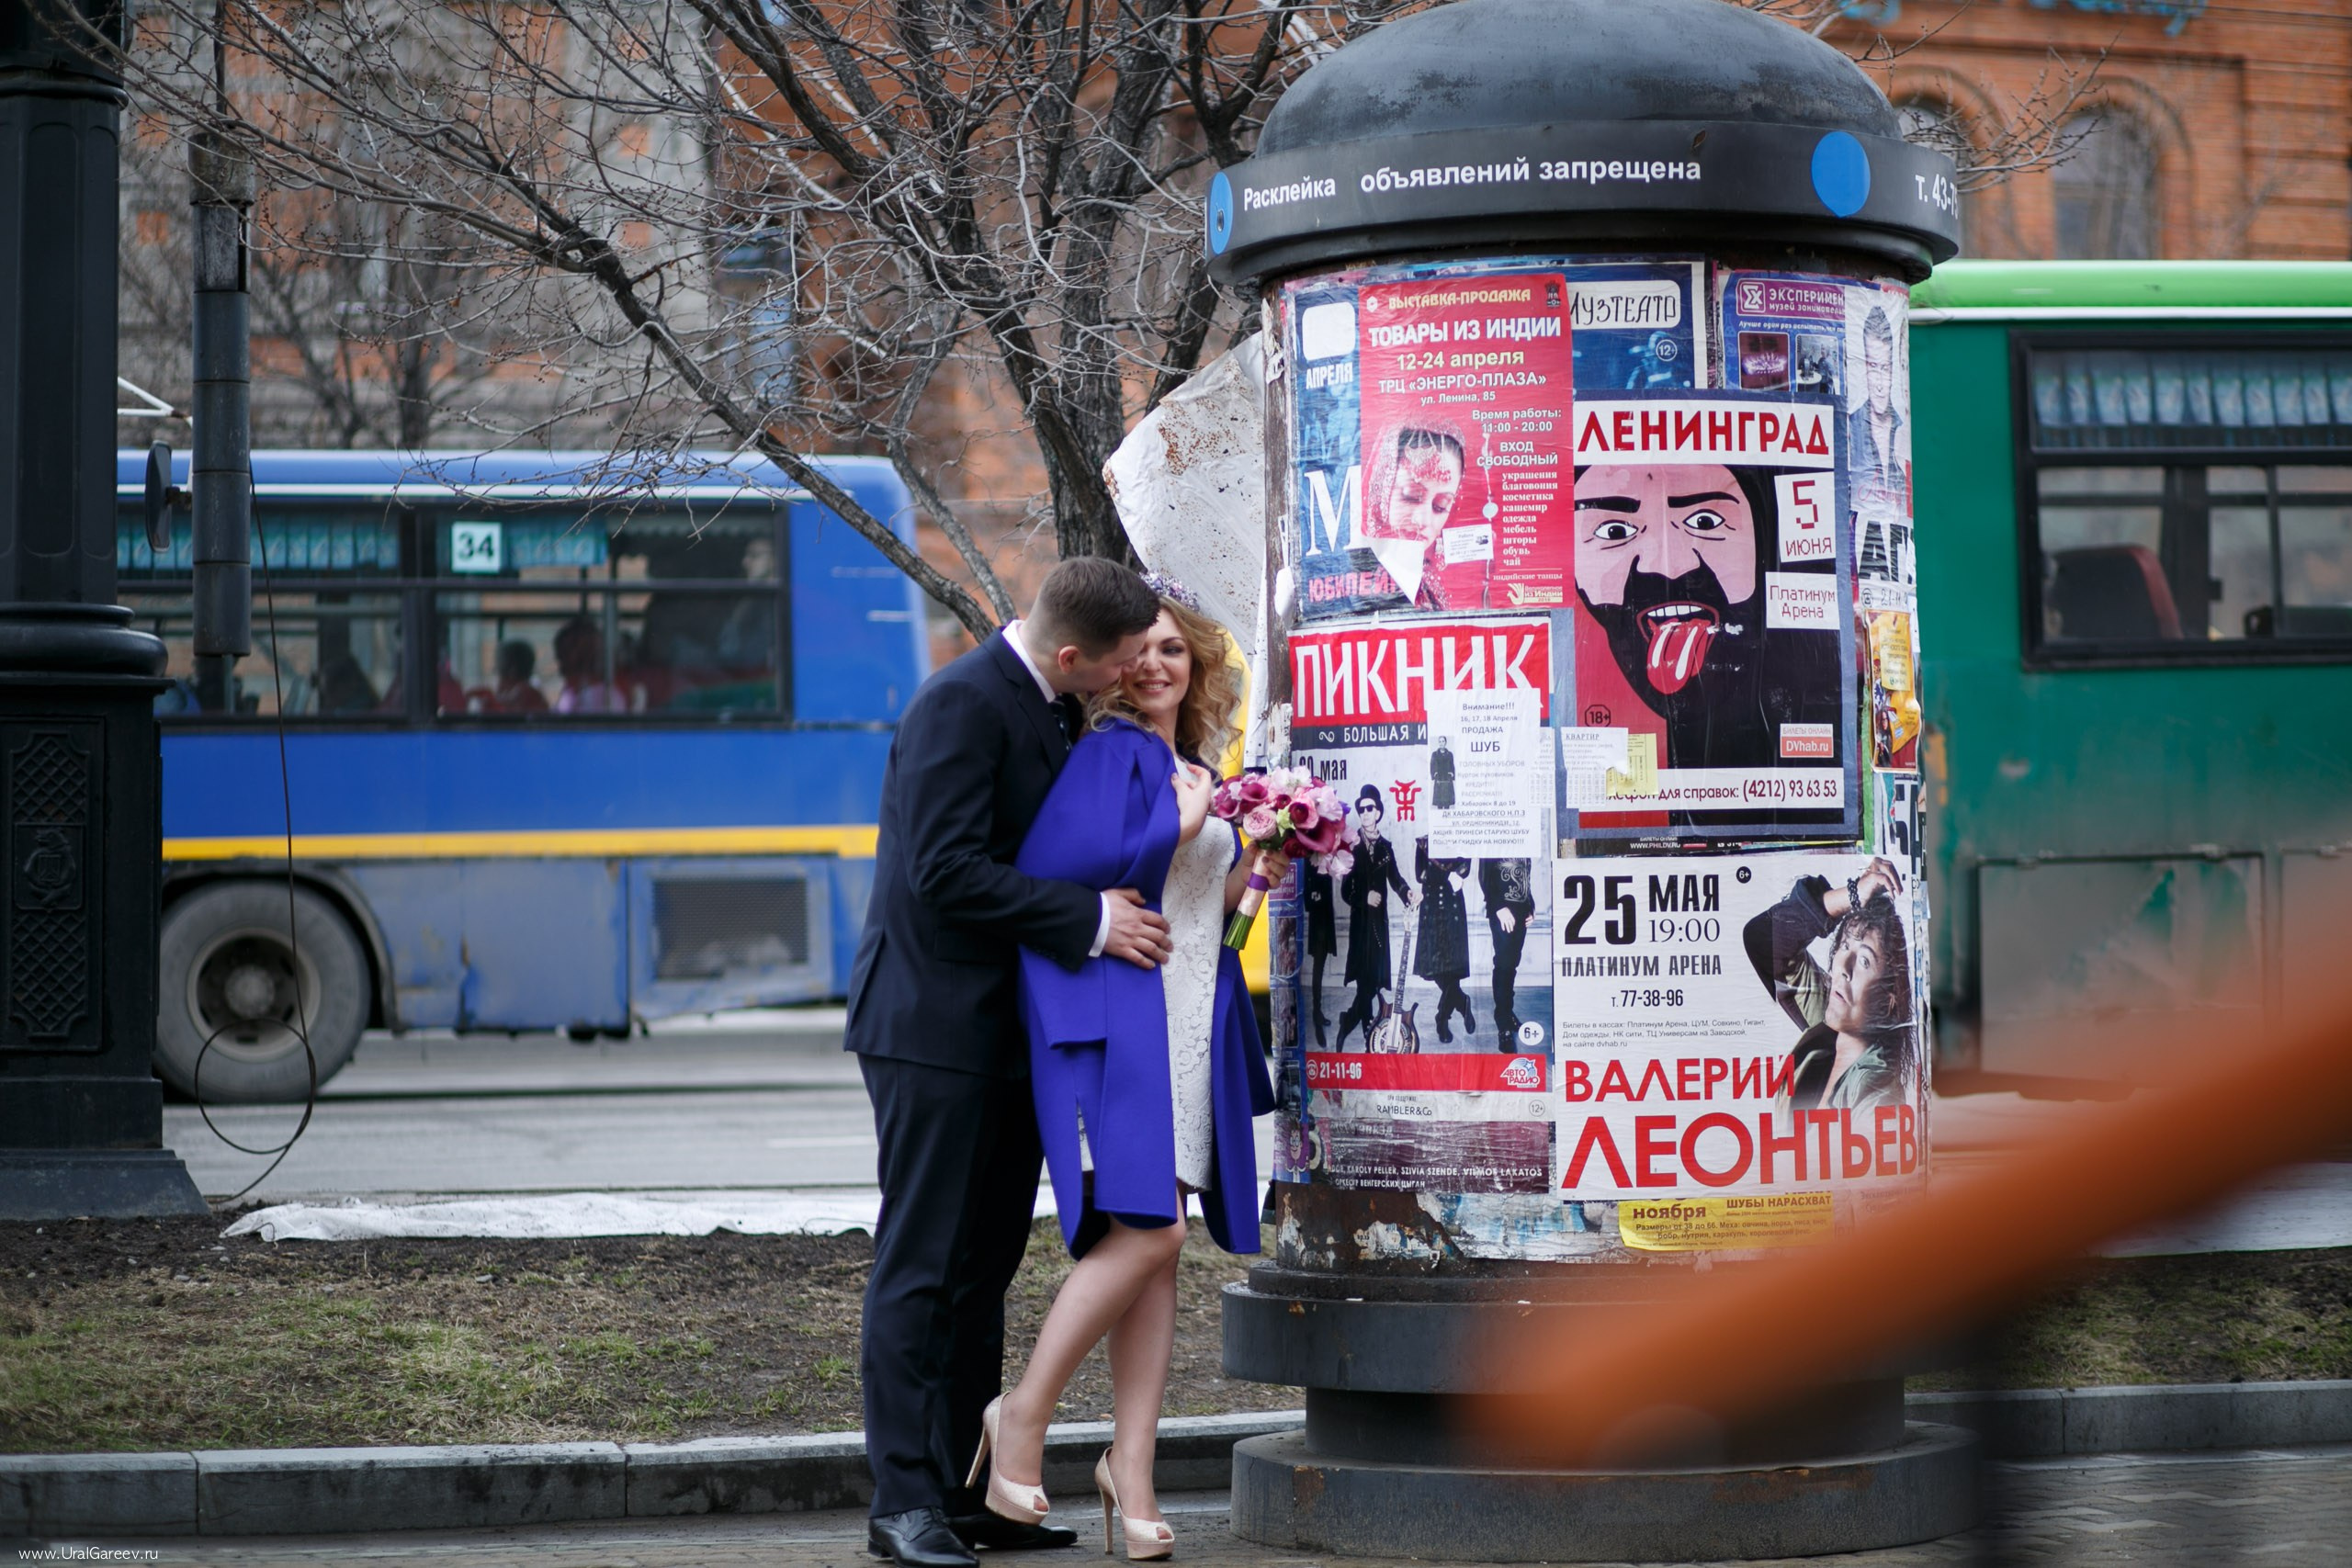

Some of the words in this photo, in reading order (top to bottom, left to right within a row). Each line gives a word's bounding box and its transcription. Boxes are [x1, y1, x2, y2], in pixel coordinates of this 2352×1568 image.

[1243, 175, 1336, 211] Расклейка
[1361, 156, 1530, 193] объявлений
[1539, 159, 1702, 185] запрещена
[1388, 288, 1531, 310] ВЫСТАВКА-ПРОДАЖА
[1770, 303, 1794, 312] музей
[1368, 322, 1448, 347] ТОВАРЫ
[1453, 321, 1480, 342] ИЗ
[1486, 317, 1561, 341] ИНДИИ
[1396, 352, 1444, 370] 12-24
[1450, 351, 1524, 370] апреля
[1306, 363, 1353, 389] АПРЕЛЯ
[1379, 378, 1406, 394] ТРЦ
[1408, 372, 1547, 391] «ЭНЕРГО-ПЛАЗА»
[1420, 396, 1436, 406] ул.
[1438, 392, 1480, 403] Ленина,
[1483, 391, 1496, 401] 85
[1472, 410, 1510, 422] Время
[1513, 408, 1562, 421] работы:
[1482, 423, 1510, 433] 11:00
[1521, 422, 1553, 432] 20:00
[1577, 411, 1829, 456] ЛЕНИНГРАД
[1499, 441, 1534, 453] ВХОД
[1476, 452, 1558, 467] СВОБОДНЫЙ
[1502, 471, 1557, 481] украшения
[1502, 481, 1558, 491] благовония
[1502, 493, 1554, 502] косметика
[1502, 504, 1547, 513] кашемир
[1792, 480, 1818, 529] 5
[1502, 515, 1536, 524] одежда
[1502, 525, 1537, 534] мебель
[458, 532, 494, 560] 34
[1502, 536, 1537, 546] шторы
[1503, 546, 1530, 557] обувь
[1503, 557, 1521, 566] чай
[1770, 585, 1836, 604] Платинум
[1781, 603, 1824, 620] Арена
[1295, 634, 1544, 718] ПИКНИК
[1463, 703, 1515, 711] Внимание!!!
[1589, 711, 1610, 723] 18+
[1344, 724, 1408, 744] БОЛЬШАЯ
[1462, 727, 1504, 735] ПРОДАЖА
[1470, 741, 1500, 752] ШУБ
[1786, 740, 1828, 751] DVhab.ru
[1320, 760, 1347, 781] мая
[1658, 788, 1680, 800] для
[1684, 787, 1739, 801] справок:
[1743, 779, 1785, 802] (4212)
[1789, 780, 1804, 797] 93
[1806, 780, 1821, 797] 63
[1823, 780, 1837, 797] 53
[1738, 870, 1750, 880] 6+
[1564, 874, 1636, 945] 25
[1648, 874, 1720, 913] МАЯ
[1648, 918, 1721, 943] 19:00
[1561, 955, 1659, 977] ПЛАТИНУМ
[1668, 954, 1722, 976] АРЕНА
[1620, 989, 1684, 1008] 77-38-96
[1627, 1021, 1663, 1030] Платинум
[1523, 1027, 1539, 1040] 6+
[1646, 1030, 1657, 1038] ТЦ
[1659, 1030, 1698, 1038] Универсам
[1319, 1062, 1362, 1080] 21-11-96
[1503, 1068, 1526, 1077] АВТО
[1510, 1076, 1539, 1084] РАДИО
[1565, 1055, 1795, 1102] ВАЛЕРИЙ
[1377, 1105, 1432, 1116] RAMBLER&Co
[1531, 1104, 1544, 1113] 12+
[1561, 1104, 1918, 1190] ЛЕОНТЬЕВ
[1427, 1168, 1461, 1177] SZENDE,
[1727, 1199, 1764, 1209] ШУБЫ
[1768, 1196, 1831, 1207] НАРАСХВАТ
[1633, 1203, 1706, 1221] ноября
[1636, 1223, 1671, 1232] Размеры
